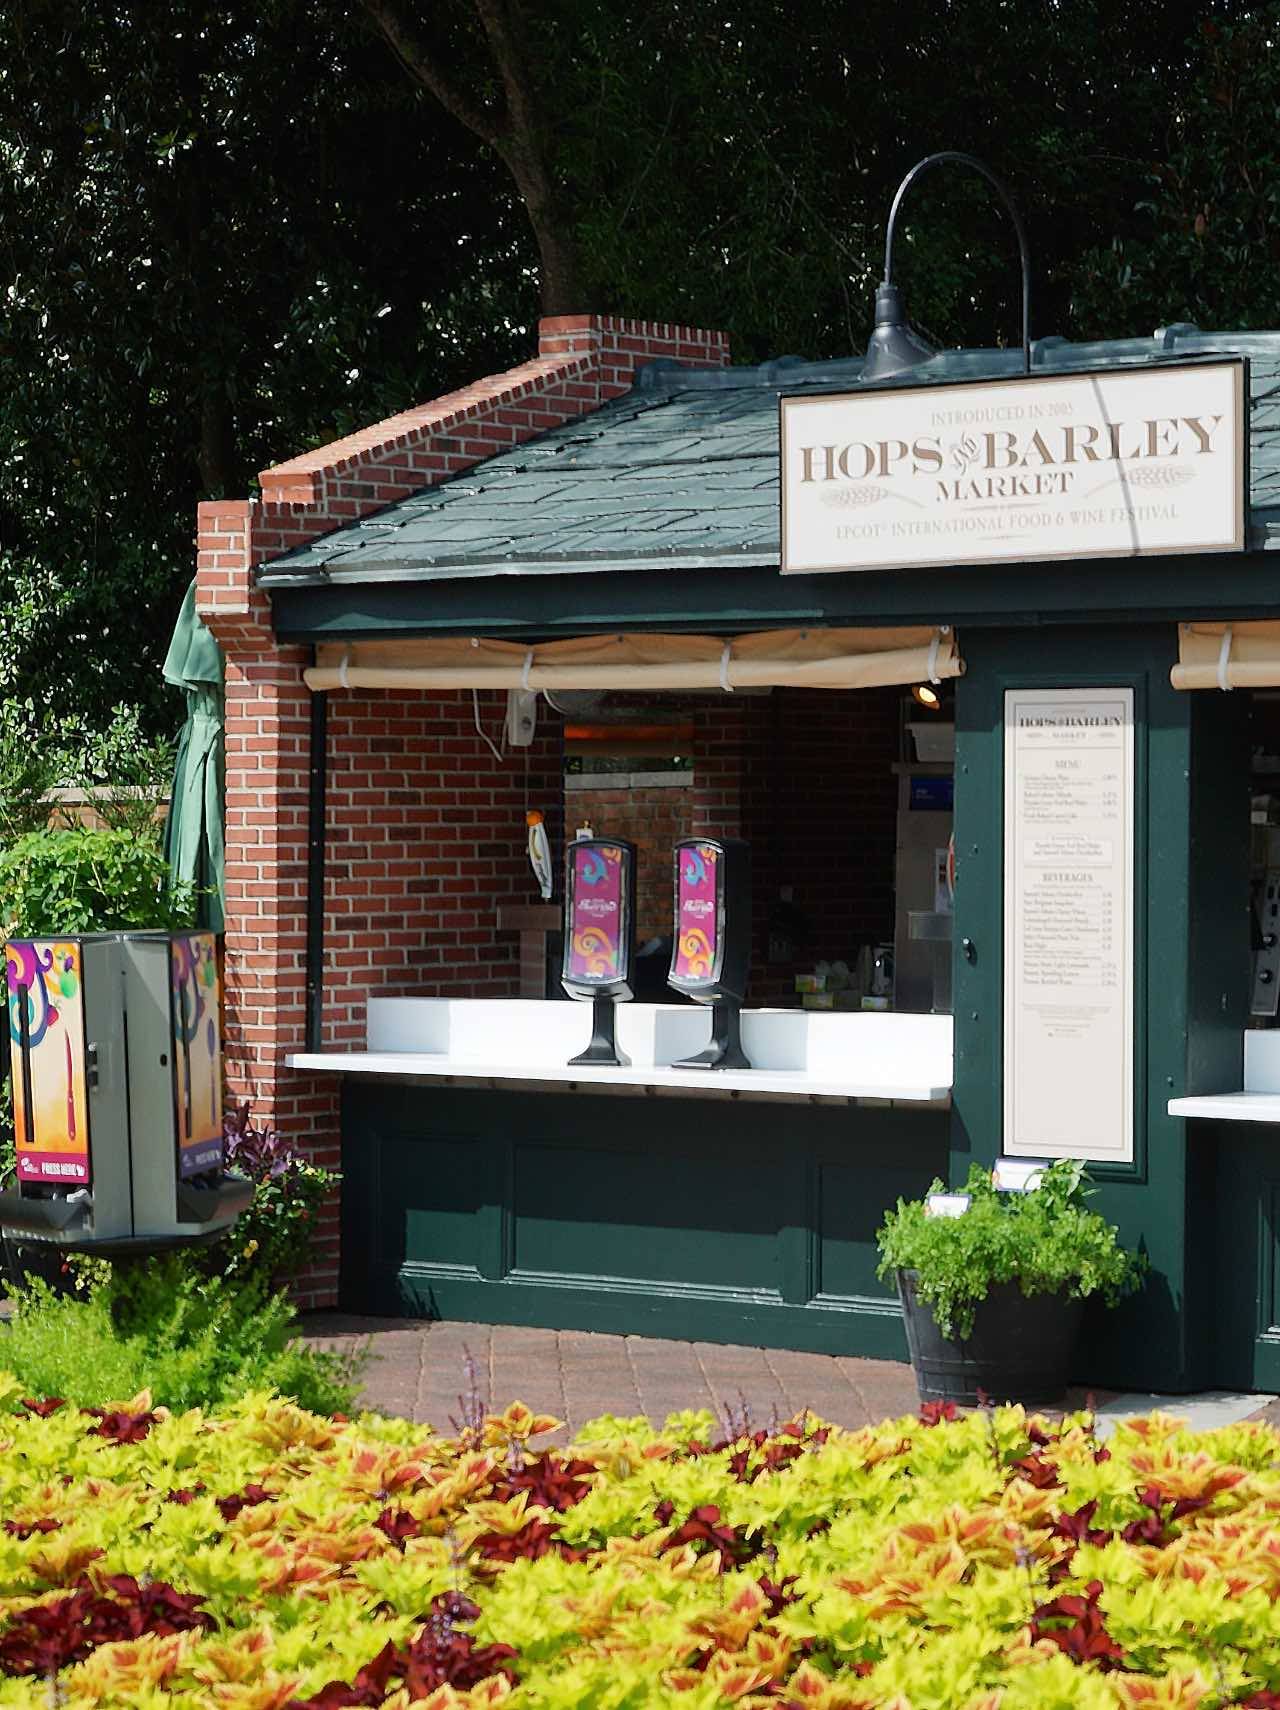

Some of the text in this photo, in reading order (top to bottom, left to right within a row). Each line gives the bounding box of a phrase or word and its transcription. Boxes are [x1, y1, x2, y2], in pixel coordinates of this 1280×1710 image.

[931, 405, 1025, 426] INTRODUCED
[1028, 403, 1045, 420] IN
[799, 436, 945, 483] HOPS
[982, 414, 1224, 470] BARLEY
[935, 471, 1075, 503] MARKET
[892, 513, 1005, 538] INTERNATIONAL
[1009, 510, 1052, 530] FOOD
[1069, 507, 1107, 526] WINE
[1109, 503, 1179, 522] FESTIVAL
